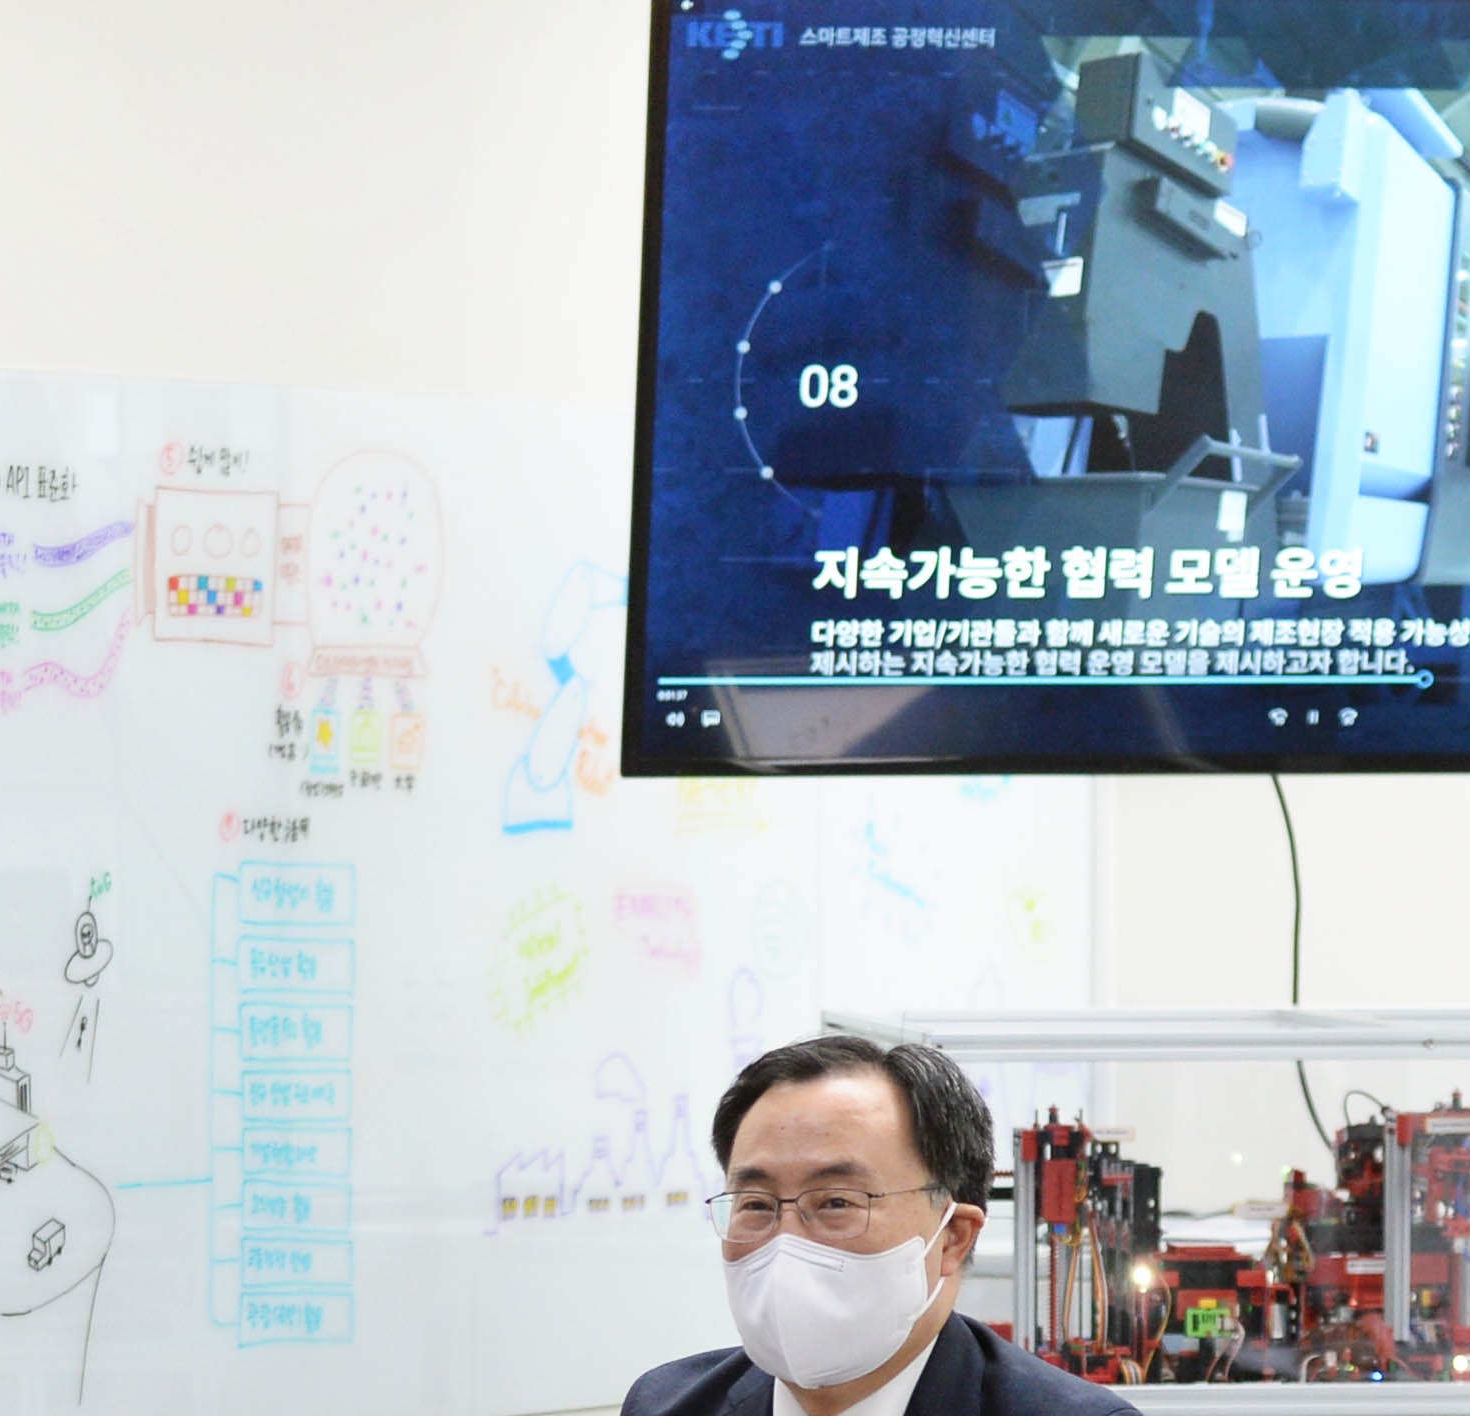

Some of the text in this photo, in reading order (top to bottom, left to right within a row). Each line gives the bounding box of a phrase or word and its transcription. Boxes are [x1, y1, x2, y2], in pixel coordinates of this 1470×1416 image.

[799, 25, 997, 50] 스마트제조 공정혁신센터
[799, 363, 860, 409] 08
[811, 545, 1365, 600] 지속가능한 협력 모델 운영
[810, 618, 886, 648] 다양한
[888, 618, 1042, 650] 기업/기관들과
[1044, 618, 1096, 648] 함께
[1098, 618, 1170, 648] 새로운
[1174, 618, 1246, 648] 기술의
[1247, 618, 1346, 648] 제조현장
[1347, 618, 1397, 648] 적용
[809, 650, 1416, 677] 제시하는 지속가능한 협력 운영 모델을 제시하고자 합니다.
